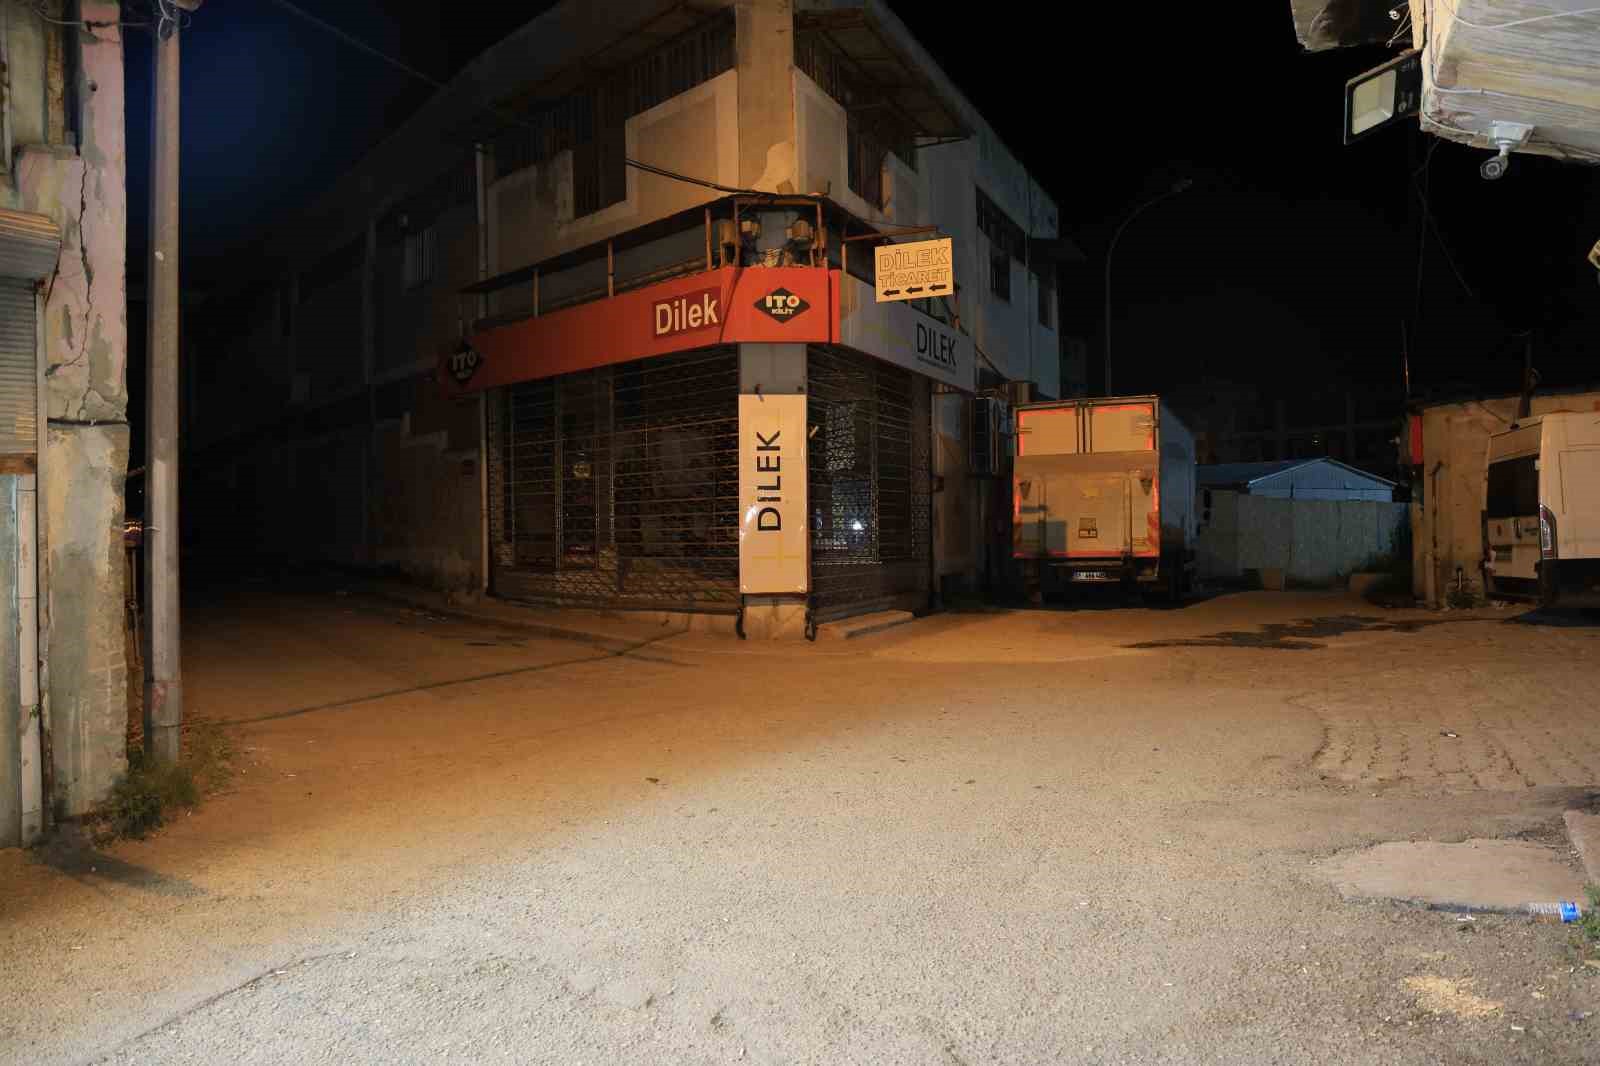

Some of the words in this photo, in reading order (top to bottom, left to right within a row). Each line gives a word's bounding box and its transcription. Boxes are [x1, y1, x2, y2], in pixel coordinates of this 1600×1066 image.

[656, 293, 718, 334] Dilek
[917, 322, 957, 367] DILEK
[756, 430, 781, 531] DILEK
